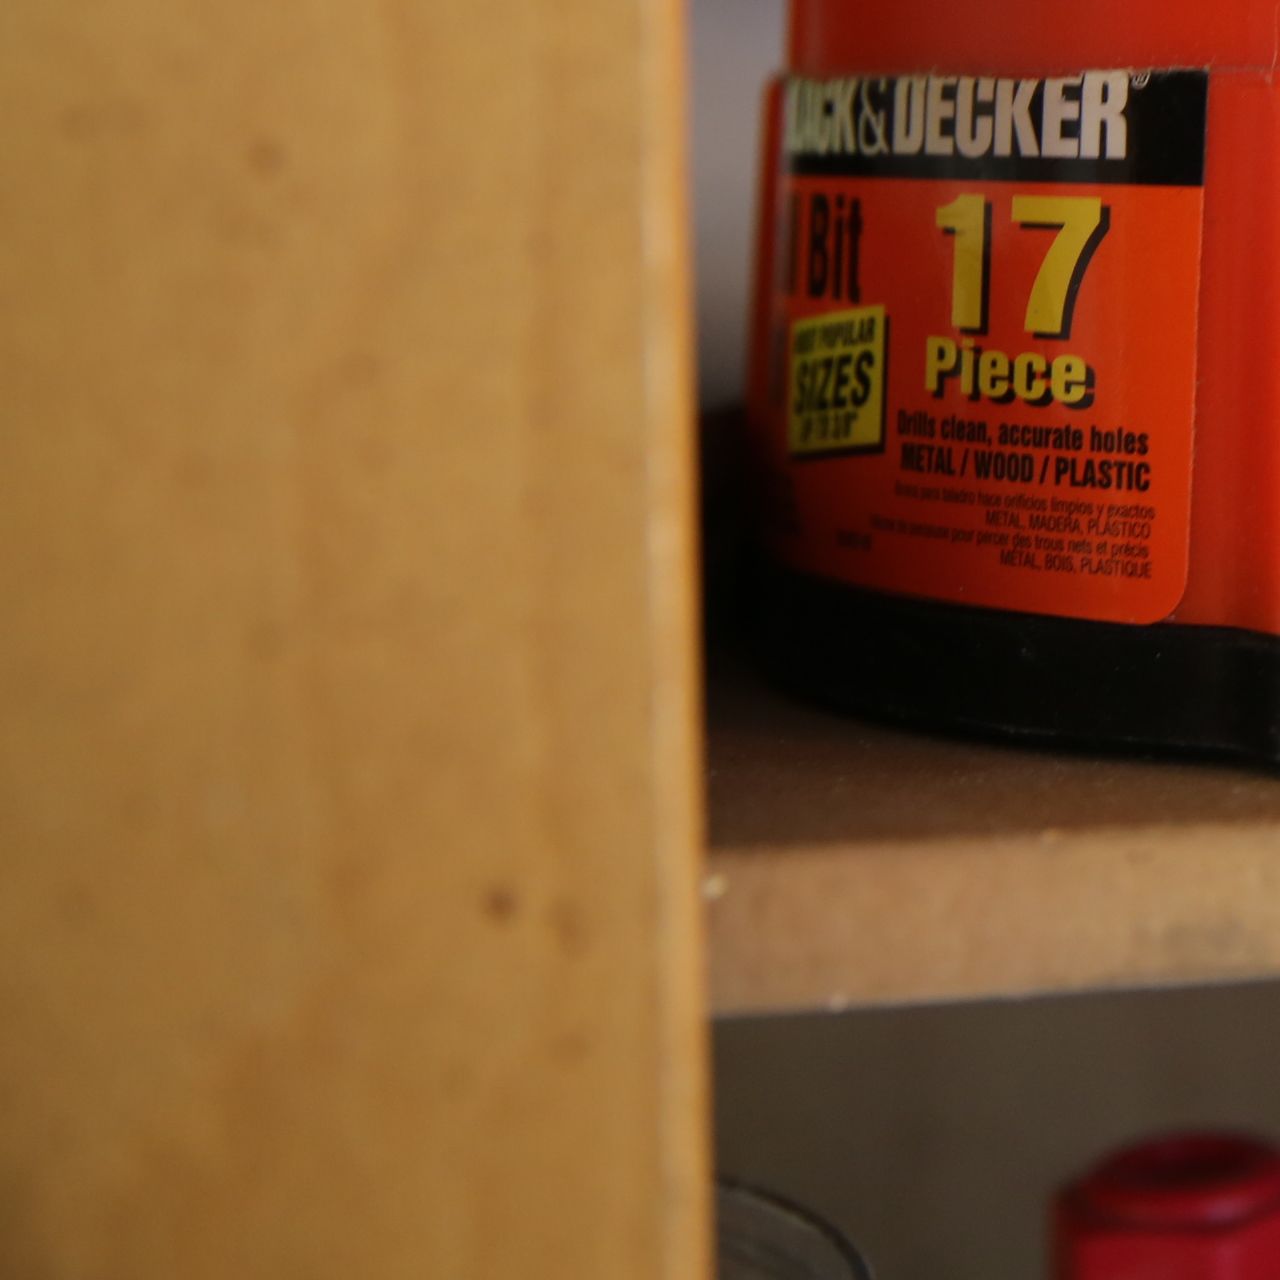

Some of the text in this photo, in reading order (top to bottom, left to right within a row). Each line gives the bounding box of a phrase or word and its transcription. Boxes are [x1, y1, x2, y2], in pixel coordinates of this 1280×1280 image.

[807, 193, 863, 304] Bit
[936, 193, 1108, 338] 17
[794, 350, 875, 417] SIZES
[926, 336, 1092, 408] Piece
[897, 410, 1149, 457] Drills clean, accurate holes
[899, 442, 956, 476] METAL
[974, 450, 1035, 484] WOOD
[1055, 457, 1151, 492] PLASTIC
[1003, 493, 1048, 512] orificios
[1050, 497, 1094, 517] limpios
[1107, 504, 1156, 521] exactos
[1035, 535, 1064, 551] trous
[1080, 556, 1153, 579] PLASTIQUE
